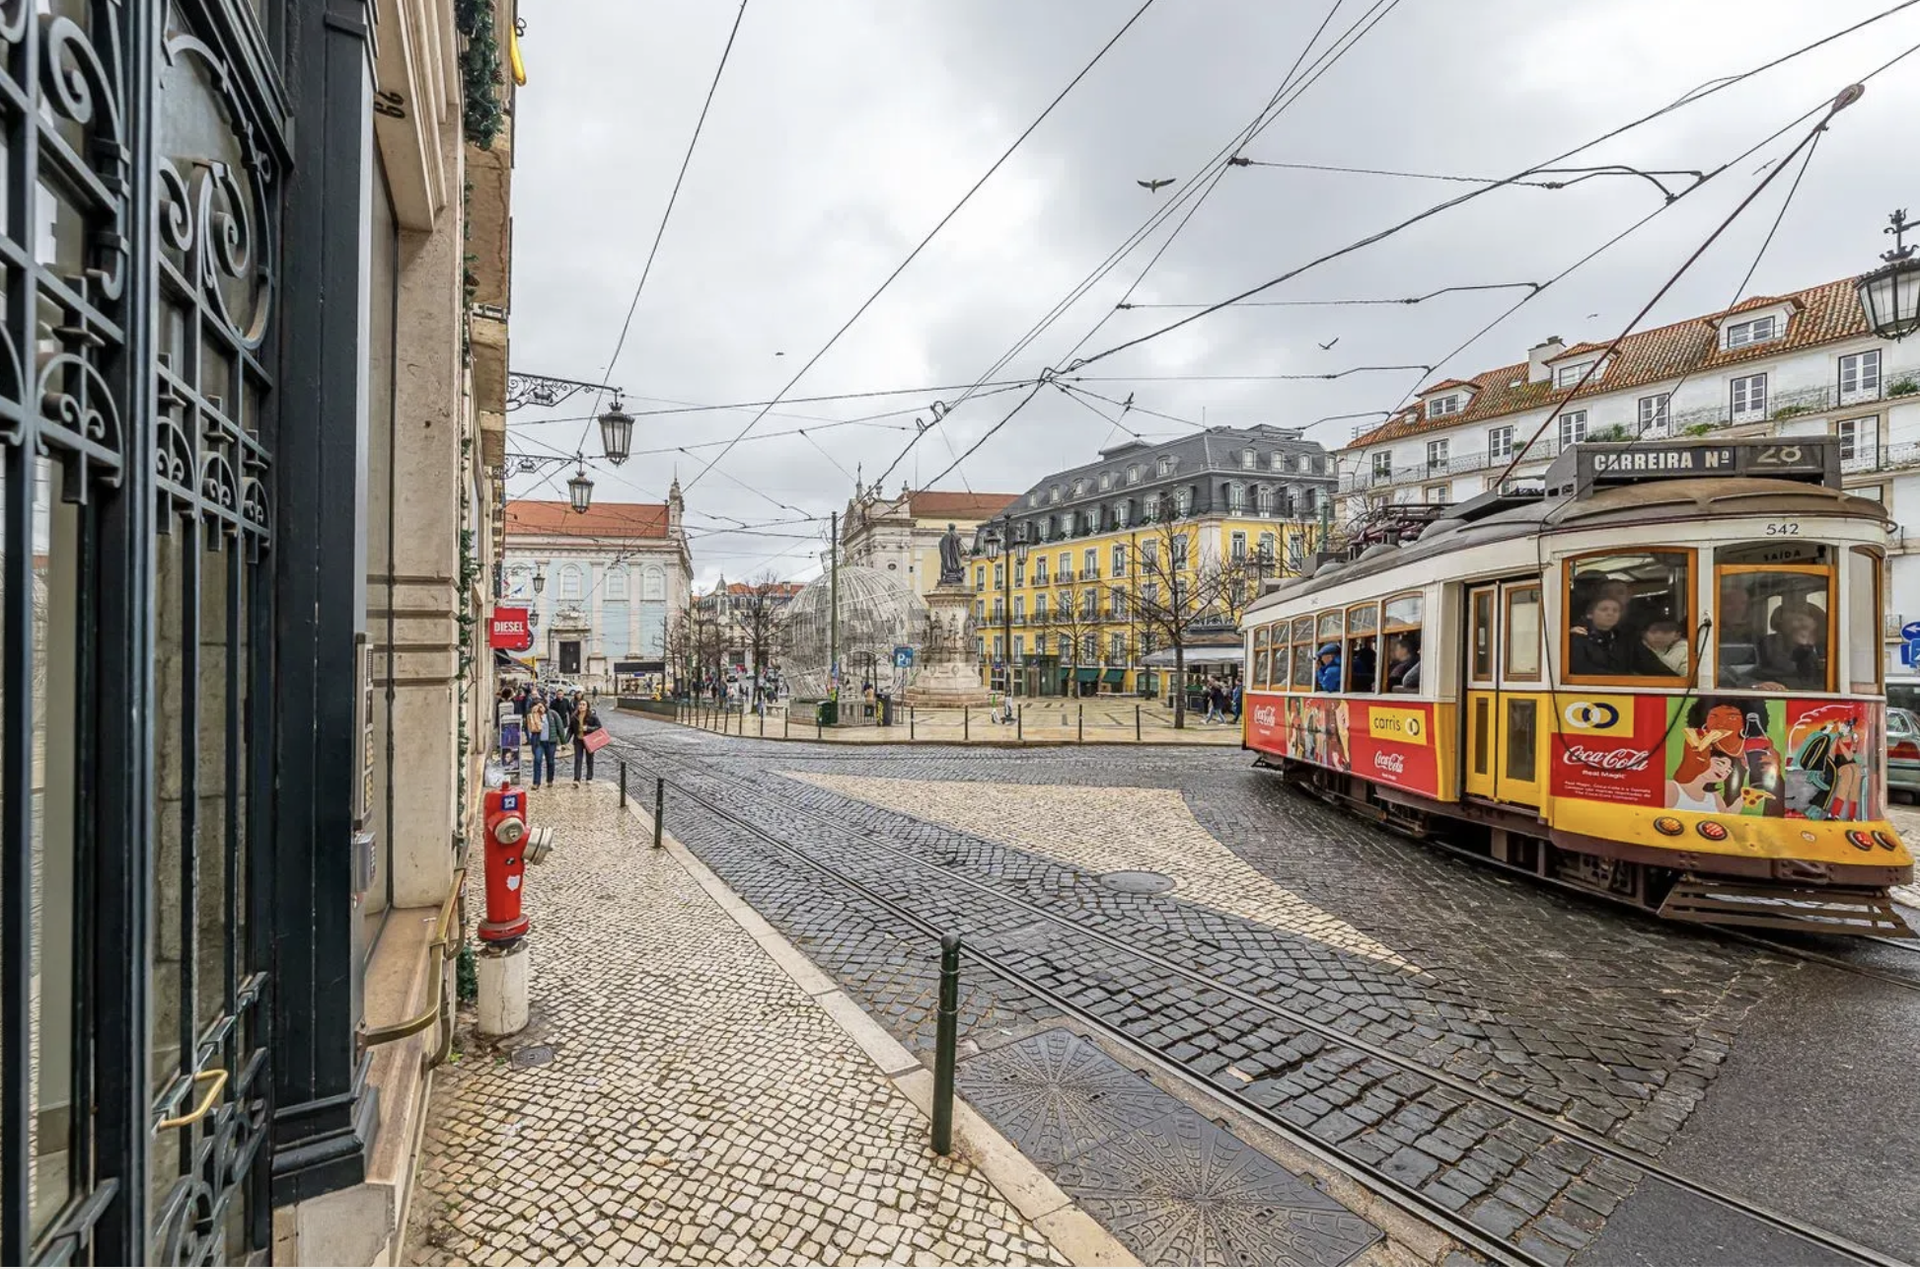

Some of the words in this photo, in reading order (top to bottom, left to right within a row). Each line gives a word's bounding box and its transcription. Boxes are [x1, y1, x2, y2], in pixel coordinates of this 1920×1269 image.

[1594, 451, 1693, 471] CARREIRA
[1757, 446, 1802, 463] 28
[1766, 523, 1799, 536] 542
[494, 621, 525, 633] DIESEL
[1374, 715, 1401, 731] carris
[1374, 750, 1405, 774] Coca-Cola
[1563, 745, 1650, 771] Coca-Cola
